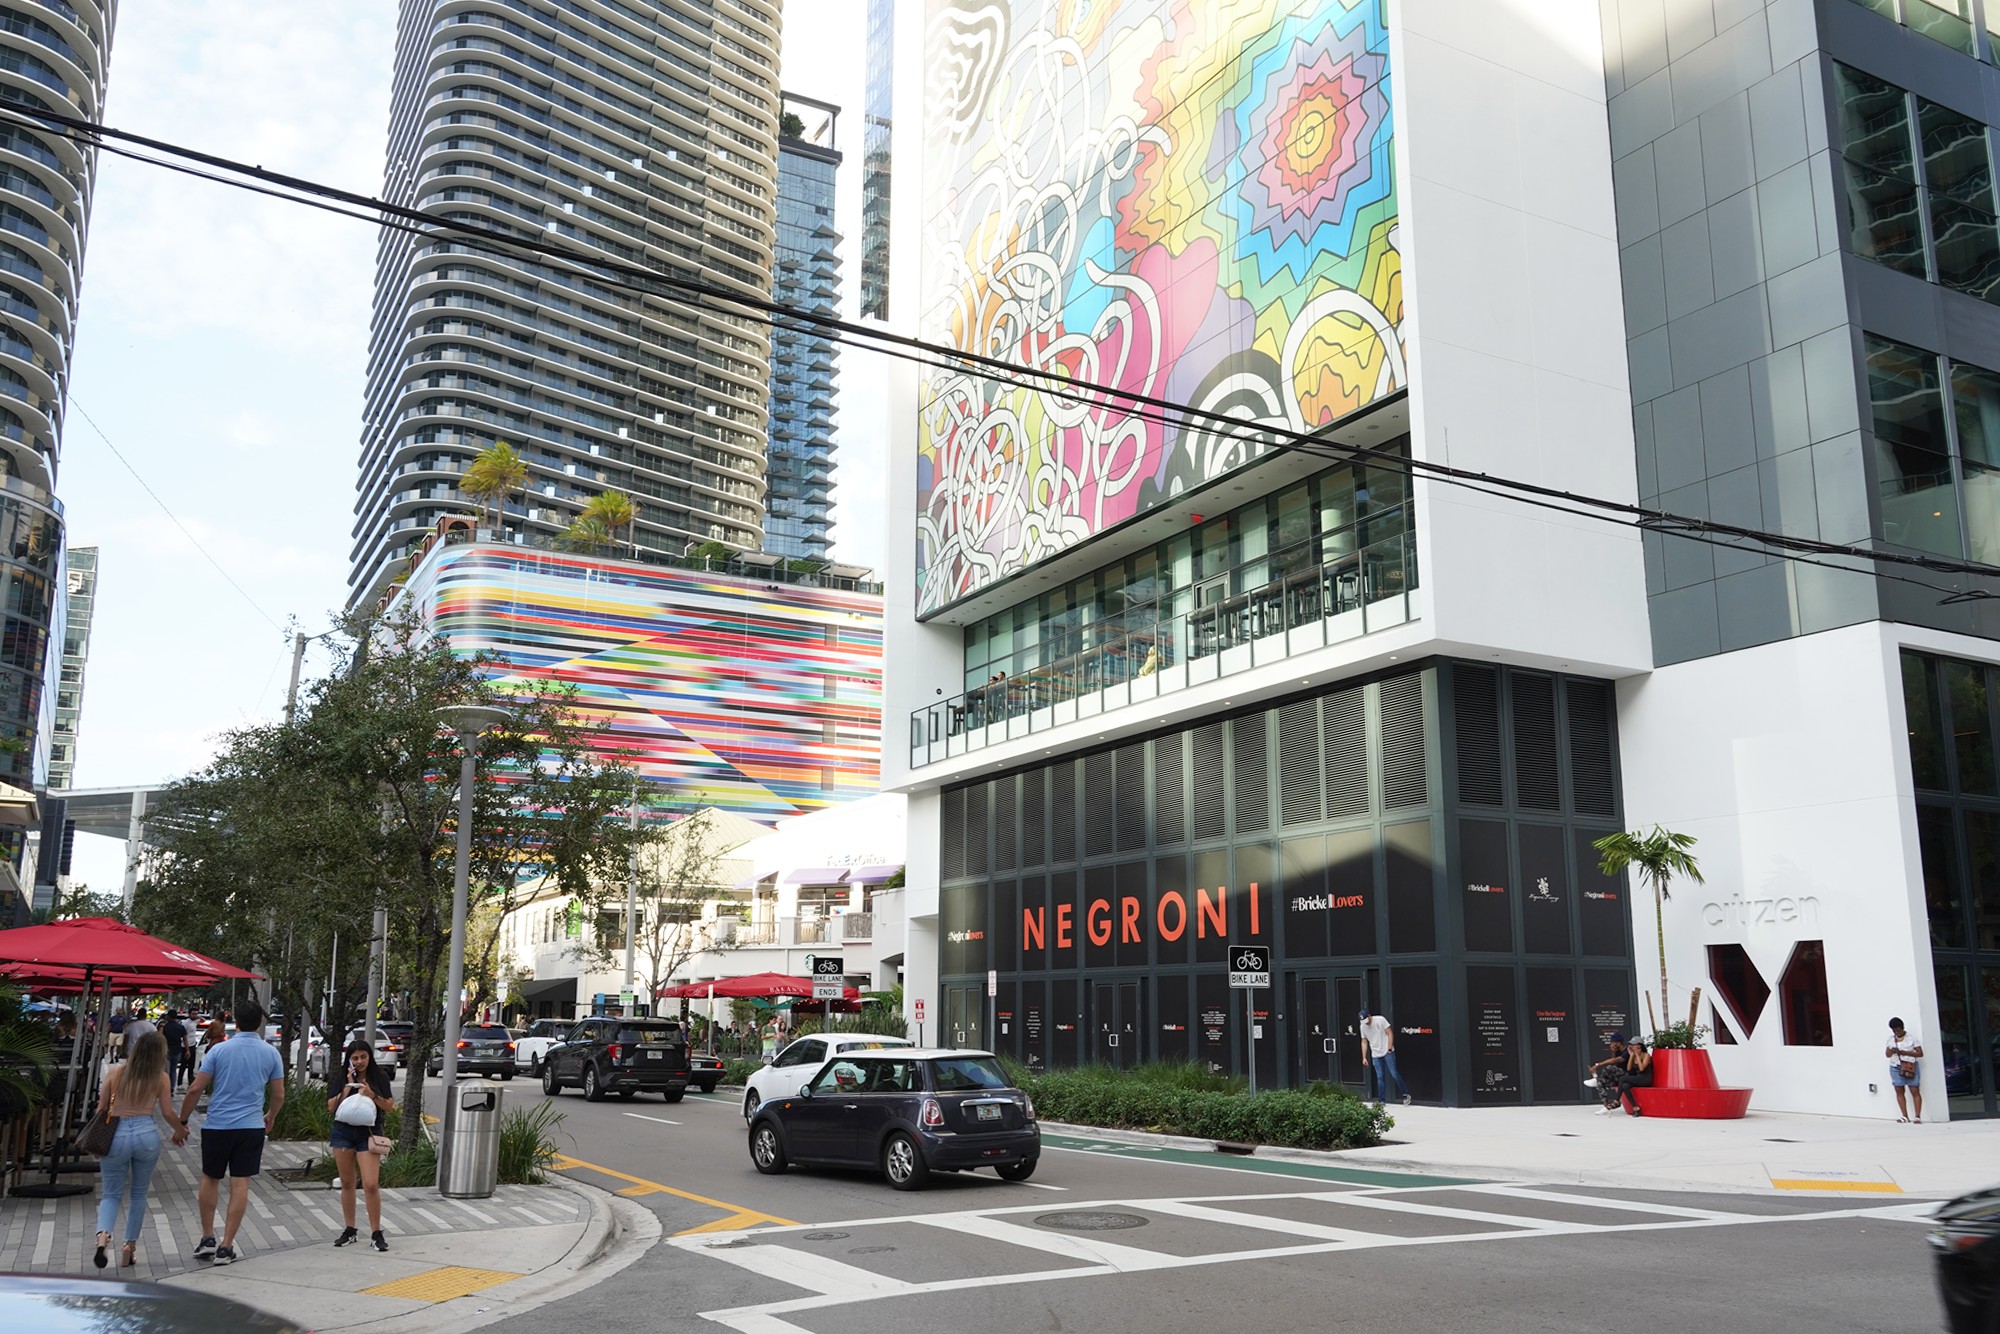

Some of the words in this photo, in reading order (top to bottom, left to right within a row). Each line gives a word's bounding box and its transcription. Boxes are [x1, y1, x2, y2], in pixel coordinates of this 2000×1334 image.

[1024, 882, 1259, 951] NEGRONI
[1702, 893, 1820, 928] citizen
[1231, 974, 1248, 984] BIKE
[1250, 974, 1268, 984] LANE
[819, 988, 837, 996] ENDS
